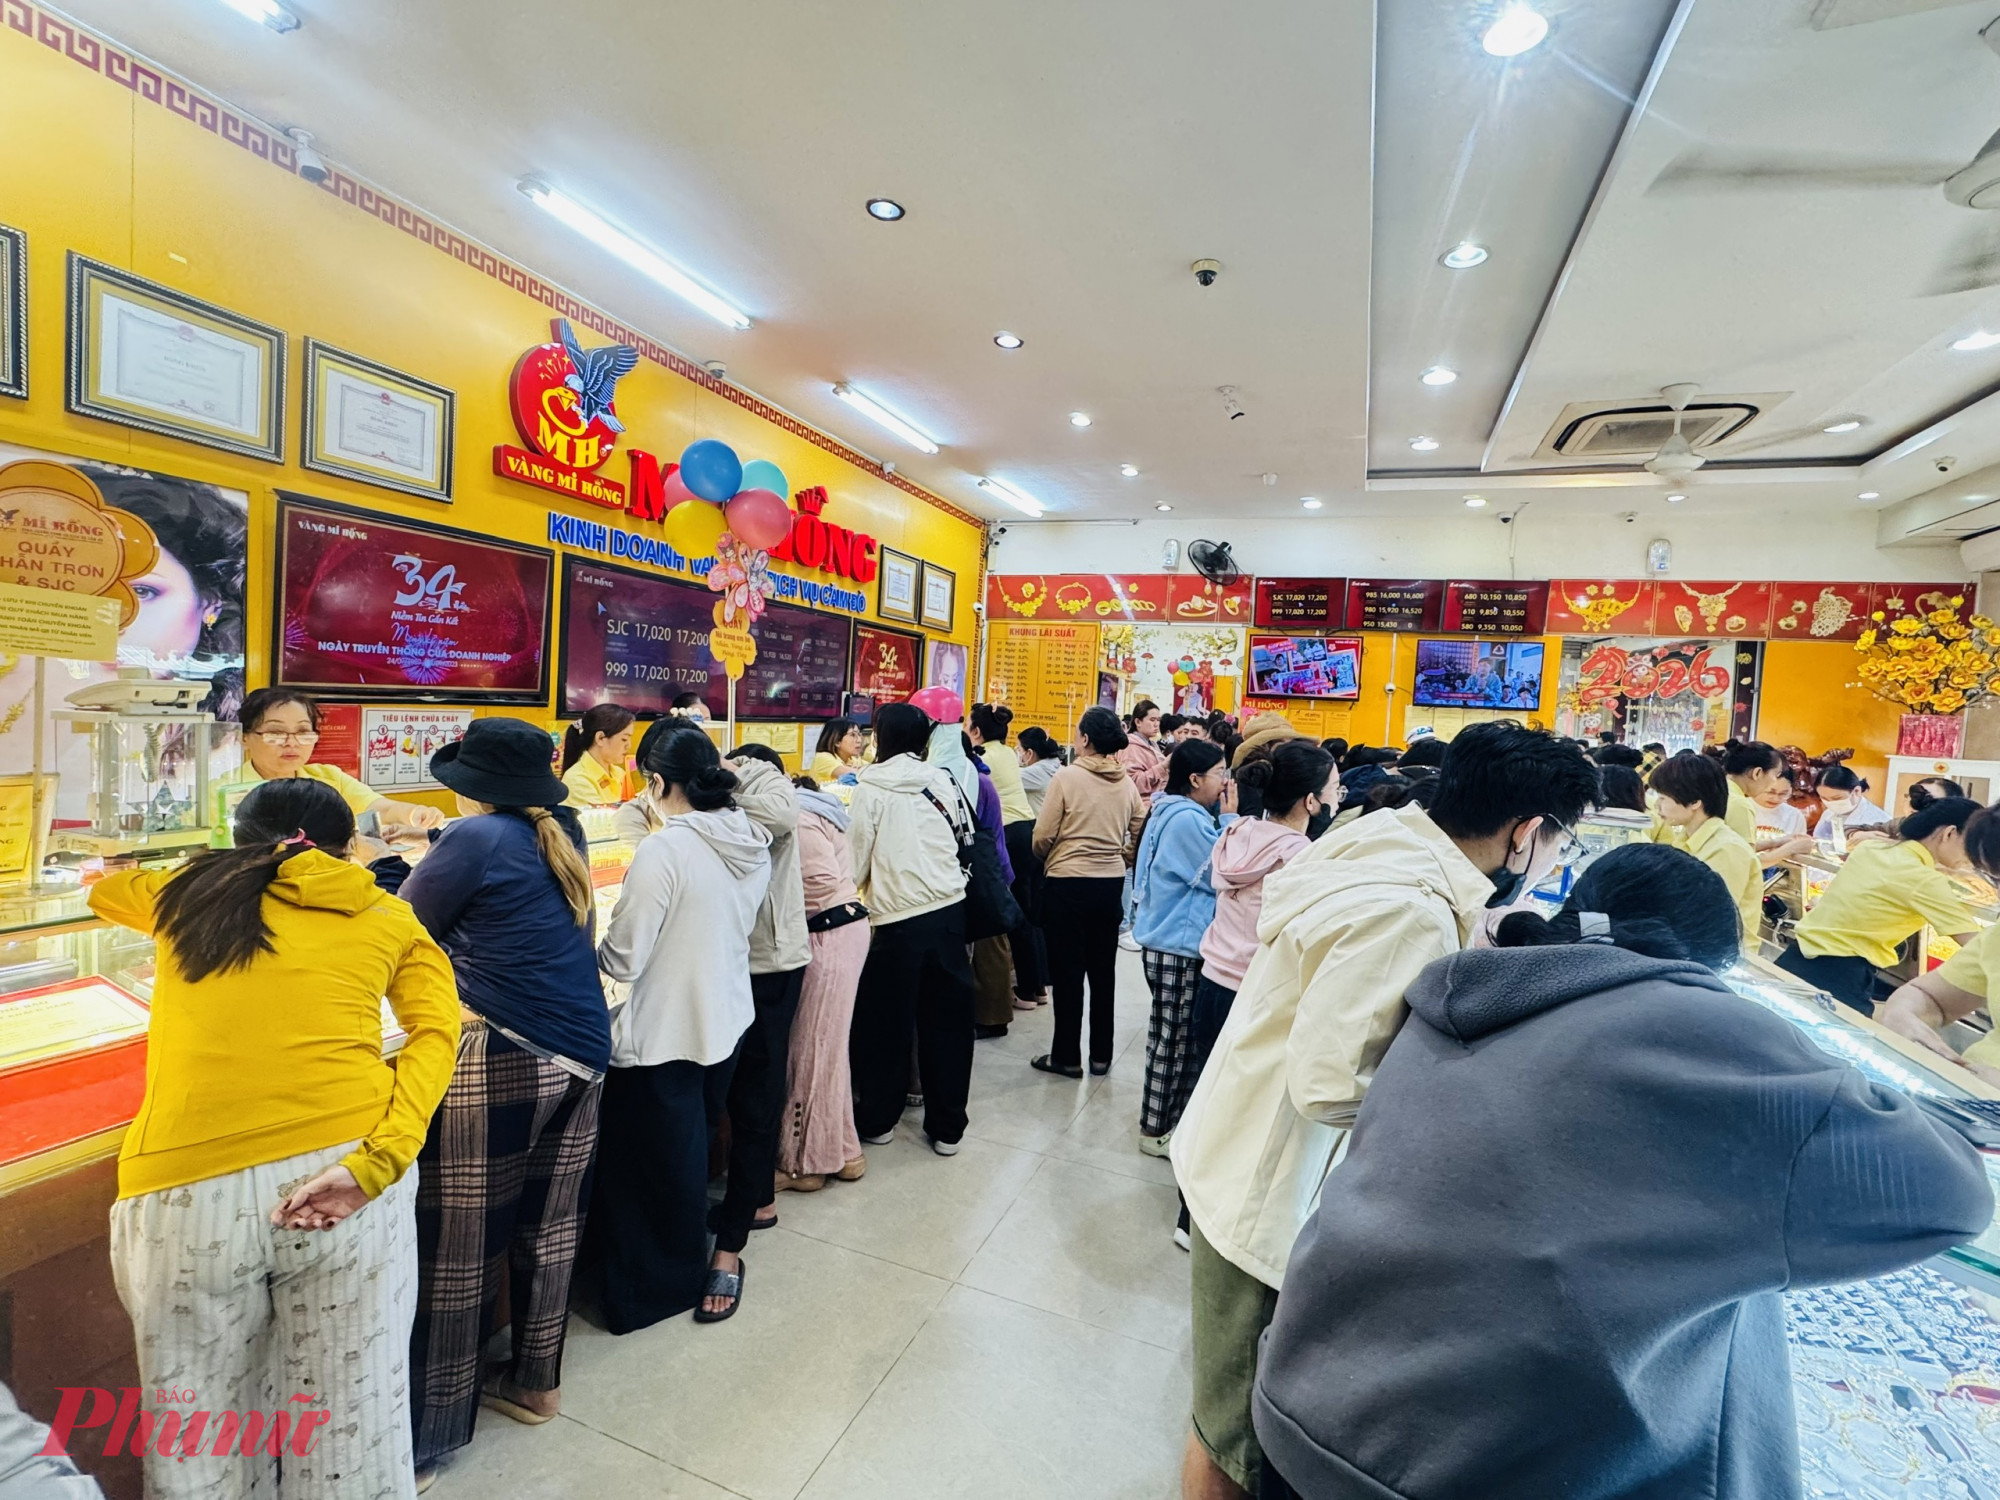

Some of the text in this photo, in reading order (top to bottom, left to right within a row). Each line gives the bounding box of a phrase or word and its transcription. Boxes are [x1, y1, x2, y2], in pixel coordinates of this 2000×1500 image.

[537, 410, 601, 468] MH
[507, 456, 554, 483] VÀNG
[581, 479, 622, 504] HỒNG
[298, 520, 326, 532] VÀNG
[342, 527, 368, 540] HỒNG
[548, 512, 608, 552] KINH
[800, 580, 821, 608] VỤ
[50, 561, 104, 578] TRƠN
[37, 577, 75, 591] SJC
[392, 554, 467, 611] 34
[1403, 592, 1424, 600] 16,600
[1480, 593, 1502, 601] 10,150
[1379, 606, 1399, 614] 15,920
[1503, 609, 1525, 617] 10,550
[607, 619, 709, 646] SJC 17,020 17,200
[1009, 626, 1076, 638] KHUNG LÃI SUẤT
[1501, 624, 1523, 632] 10,050
[318, 640, 350, 652] NGÀY
[352, 642, 390, 655] TRUYỀN
[392, 644, 426, 657] THỐNG
[449, 650, 480, 661] DOANH
[482, 652, 512, 664] NGHIỆP
[605, 661, 708, 685] 999 17,020 17,200
[1580, 645, 1730, 703] 2026
[1257, 700, 1285, 709] HỒNG
[382, 713, 458, 723] TIÊU LỆNH CHỮA CHÁY
